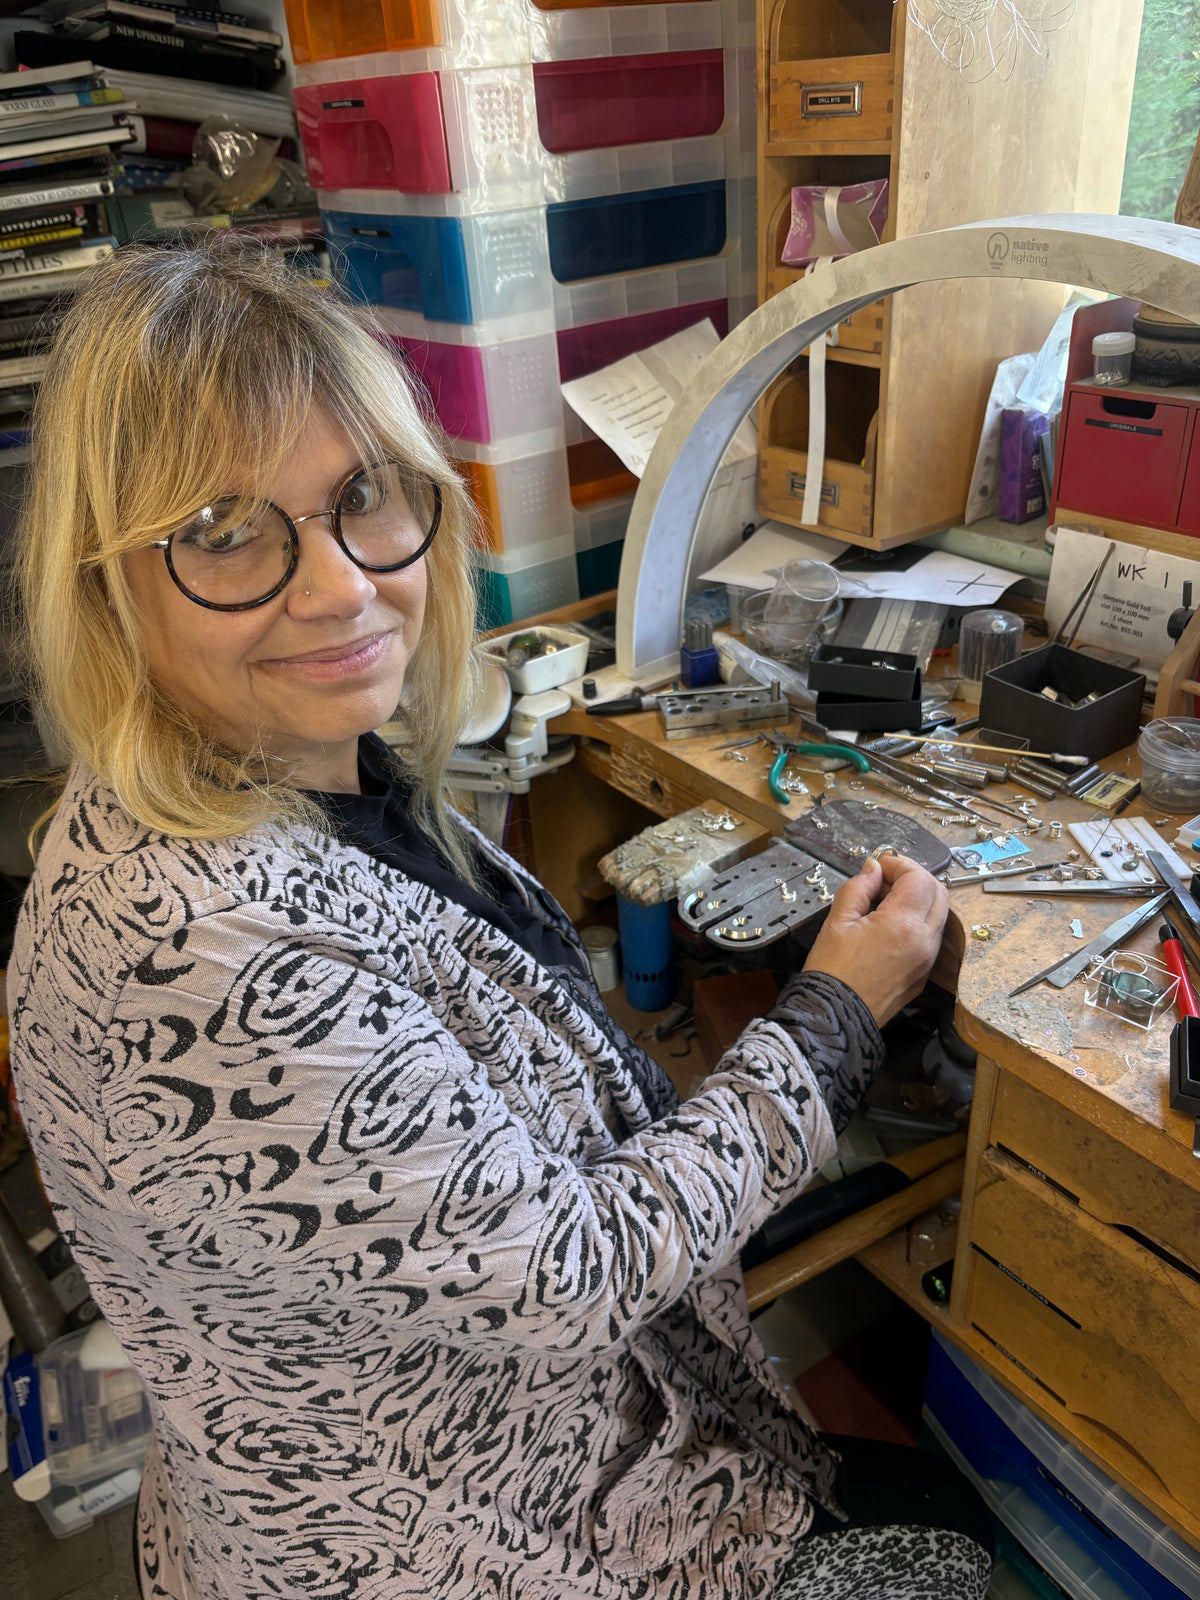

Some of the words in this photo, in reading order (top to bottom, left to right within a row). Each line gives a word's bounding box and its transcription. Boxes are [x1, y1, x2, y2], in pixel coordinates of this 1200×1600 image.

[116, 24, 135, 38] NEW
[136, 28, 186, 48] UPHOLSTERY
[1, 101, 31, 112] WARM
[31, 98, 57, 110] GLASS
[1, 213, 72, 233] CONTEMPORARY
[1012, 238, 1049, 252] native
[1011, 250, 1048, 267] lighting
[1117, 561, 1147, 581] WK
[1100, 602, 1111, 610] size
[1112, 604, 1122, 613] 100
[1127, 609, 1138, 618] 100
[1102, 593, 1125, 605] Genuine
[1126, 600, 1140, 610] Gold
[1140, 604, 1151, 612] Foil
[1117, 616, 1133, 626] sheet
[1120, 626, 1131, 635] 855
